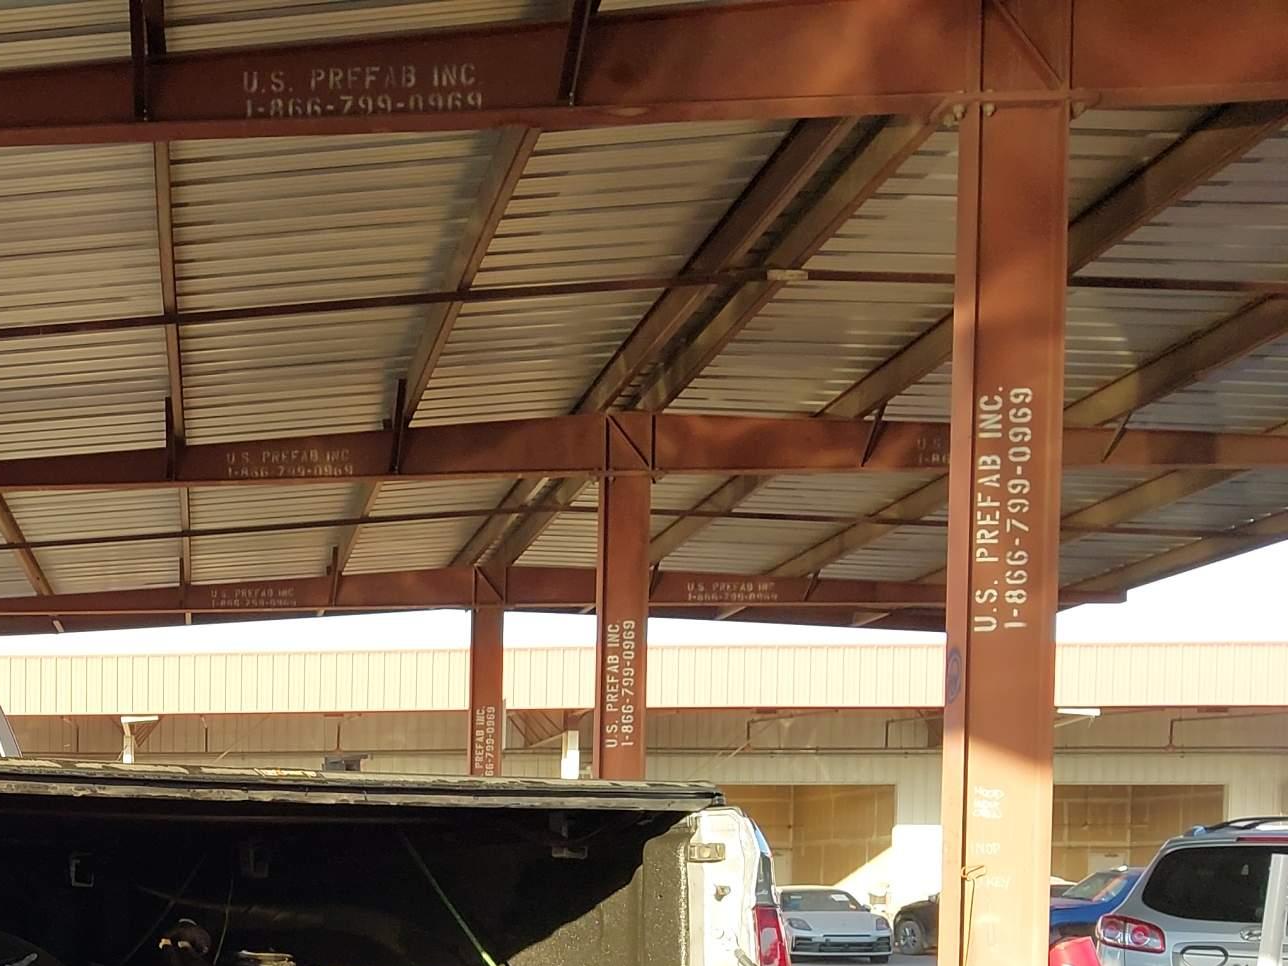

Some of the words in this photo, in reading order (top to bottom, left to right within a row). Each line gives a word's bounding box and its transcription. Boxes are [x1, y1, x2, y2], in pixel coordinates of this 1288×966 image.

[243, 71, 294, 93] U.S.
[978, 385, 1003, 438] INC.
[975, 454, 1001, 563] PREFAB
[1004, 387, 1033, 628] 1-866-799-0969
[974, 580, 998, 632] U.S.
[606, 655, 620, 712] PREFAB
[621, 620, 636, 746] 1-866-799-0969
[475, 729, 485, 769] PREFAB
[605, 720, 618, 748] U.S.
